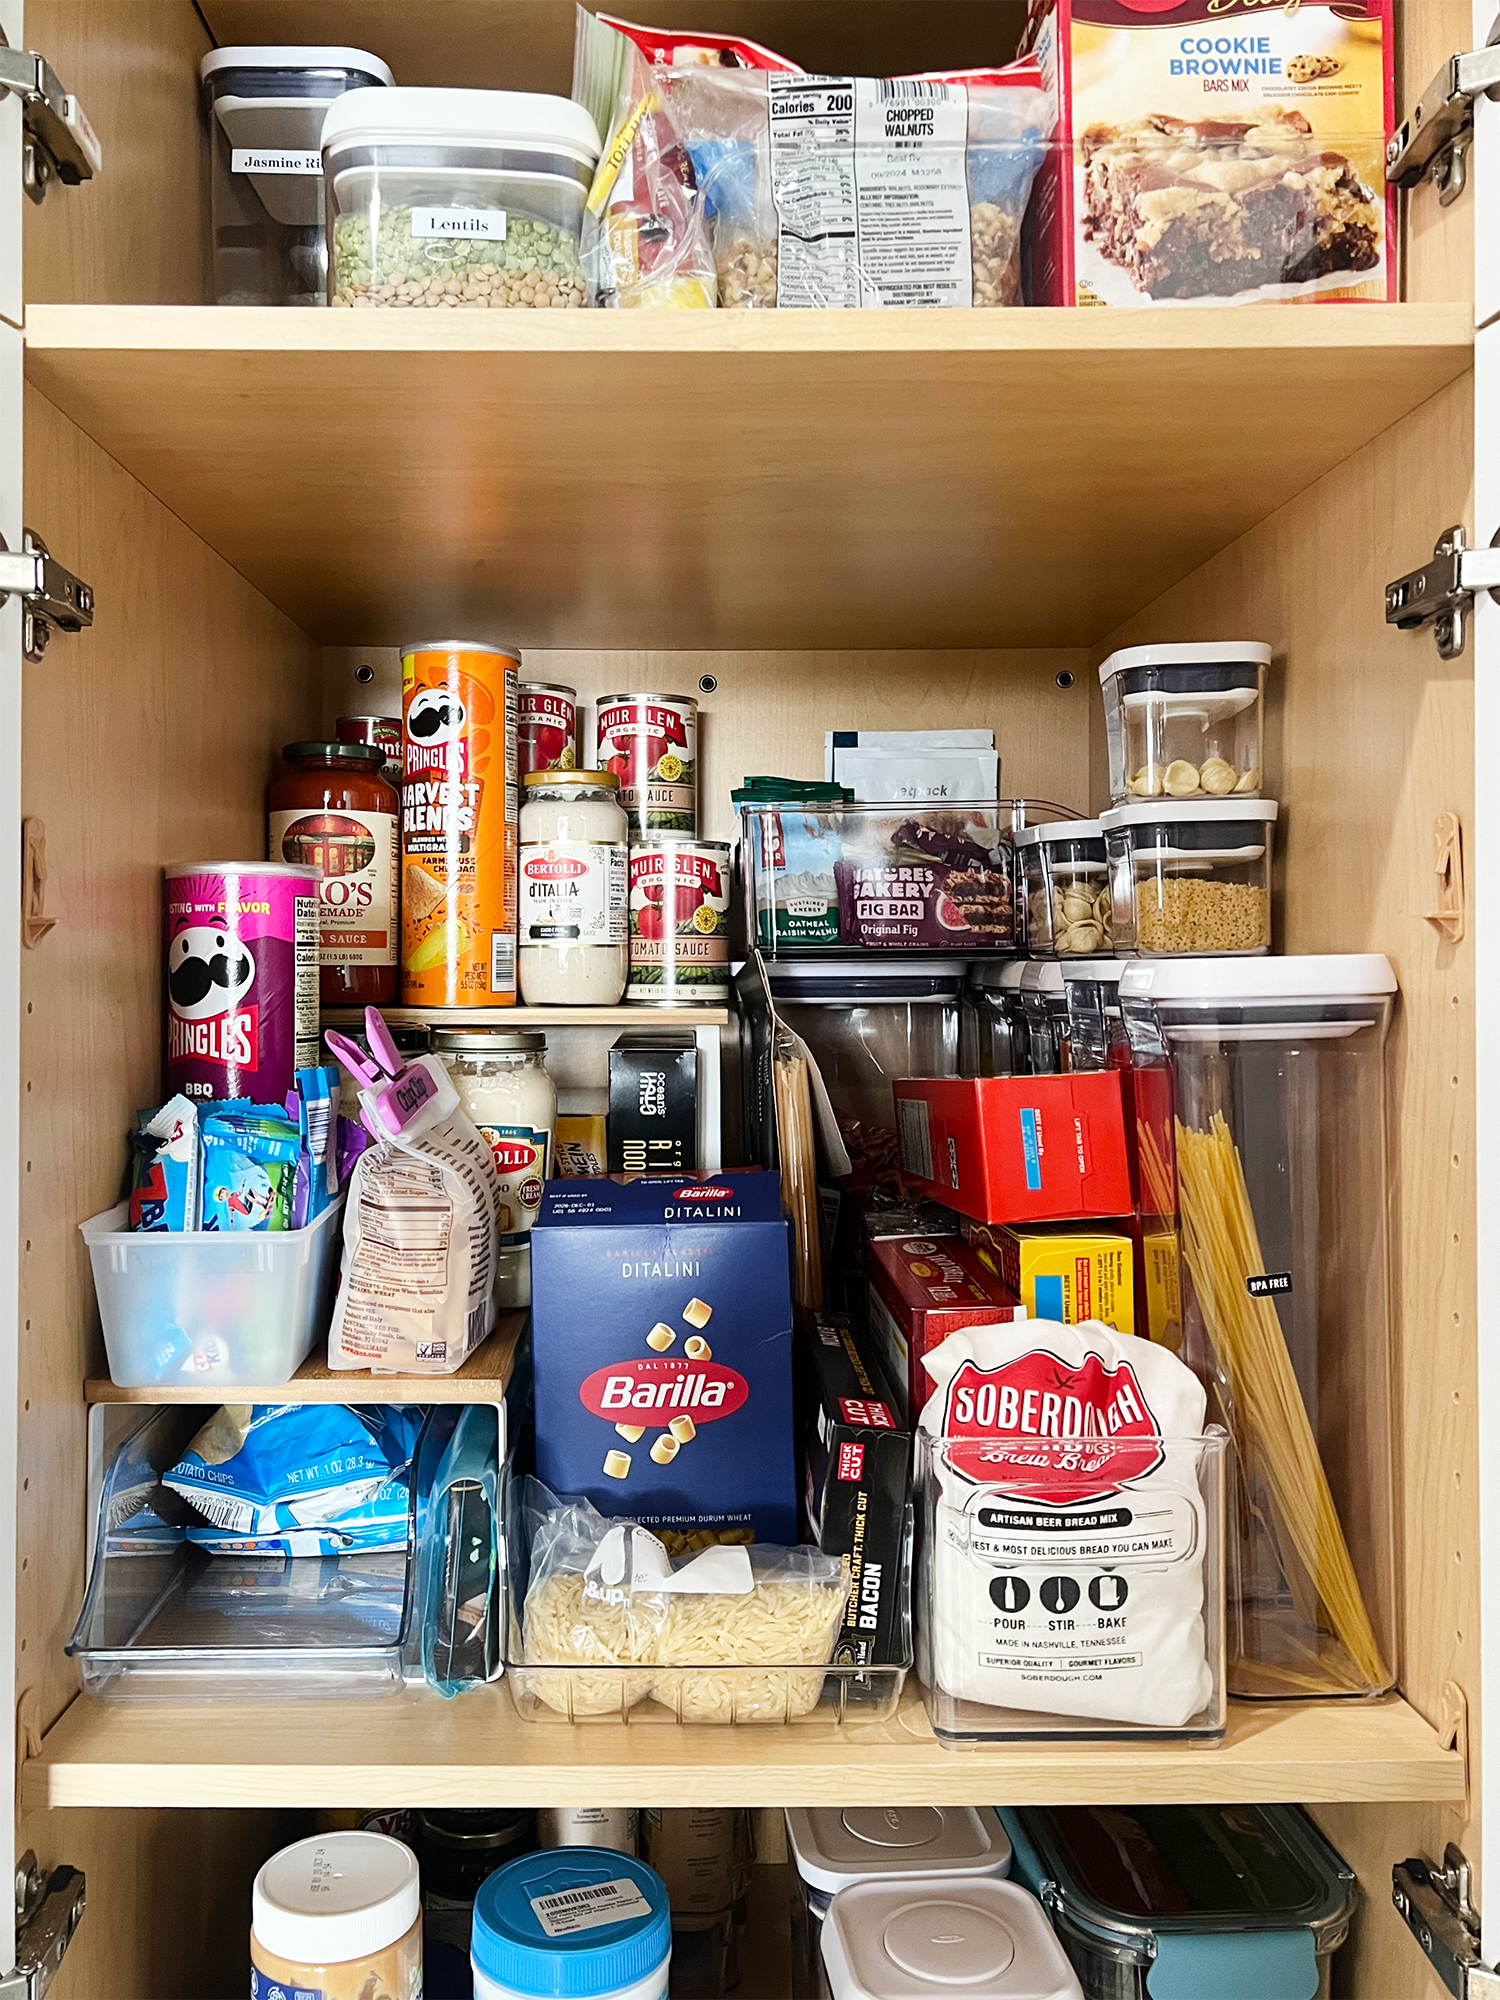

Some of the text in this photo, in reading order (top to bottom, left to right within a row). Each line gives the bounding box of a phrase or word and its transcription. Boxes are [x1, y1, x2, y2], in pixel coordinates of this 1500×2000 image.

[1180, 37, 1270, 54] COOKIE
[1170, 58, 1282, 75] BROWNIE
[1203, 79, 1250, 92] BARS MIX
[772, 95, 852, 114] Calories 200
[886, 108, 934, 122] CHOPPED
[885, 123, 934, 137] WALNUTS
[244, 156, 301, 170] Jasmine
[430, 217, 489, 232] Lentils
[521, 698, 573, 723] IR GLEN
[521, 715, 564, 727] RGANIC
[600, 709, 677, 731] MUIR GLEN
[382, 728, 399, 736] NATURAL
[407, 742, 465, 775] PRINGLES
[403, 781, 480, 806] HARVEST
[616, 789, 674, 802] ATO AUCE
[527, 863, 582, 875] BERTOLLI
[631, 859, 711, 879] MUIR GLEN
[320, 881, 373, 907] O'S
[529, 881, 580, 898] d'ITALIA
[854, 882, 934, 899] BAKERY
[194, 904, 215, 912] WITH
[218, 902, 270, 915] FAVOR
[861, 904, 919, 916] FIG BAR
[788, 920, 830, 928] OATMEAL
[861, 924, 918, 937] Original Fig
[776, 927, 839, 937] RAISIN WALNU
[329, 935, 368, 944] SAUCE
[630, 943, 710, 956] TOMATO SAUCE
[472, 962, 480, 970] NET
[465, 971, 487, 980] PESO NETO
[169, 1014, 252, 1063] PRINGLES
[185, 1083, 213, 1096] BBQ
[640, 1072, 657, 1115] HALO
[657, 1072, 667, 1116] ocean's
[623, 1140, 646, 1170] NOO
[1077, 1145, 1083, 1154] TO
[493, 1149, 529, 1165] OLLI
[522, 1185, 541, 1193] FRESH
[522, 1192, 541, 1200] CREAM
[679, 1188, 727, 1198] Barilla
[664, 1206, 741, 1219] DITALINI
[622, 1261, 700, 1278] DITALINI
[383, 1285, 400, 1293] Durum
[1251, 1277, 1289, 1291] BPA FREE
[373, 1289, 396, 1297] WHEAT
[385, 1304, 411, 1312] equipment
[369, 1315, 383, 1323] Italy
[638, 1362, 689, 1371] DAL 1877
[600, 1373, 727, 1408] Barilla
[844, 1400, 872, 1426] CUT
[867, 1402, 890, 1428] THICK
[955, 1384, 1143, 1438] SOBERDOUGH
[841, 1444, 852, 1479] THICK
[850, 1445, 863, 1480] CUT
[979, 1450, 1049, 1467] Brew
[287, 1455, 364, 1484] NET WT. 1 OZ (28.3
[207, 1470, 235, 1485] CHIPS
[380, 1487, 393, 1500] OZ.
[662, 1515, 696, 1523] PREMIUM
[727, 1514, 752, 1522] WHEAT
[990, 1513, 1118, 1527] ARTISAN BEER BREAD MIX
[993, 1538, 1173, 1556] & MOST DELICIOUS BREAD YOU CAN MAKE
[847, 1491, 868, 1627] BUTCHER THICK CUT
[859, 1563, 882, 1630] BACON
[994, 1618, 1026, 1630] POUR
[1048, 1619, 1075, 1631] STIR
[1097, 1617, 1127, 1629] BAKE
[996, 1638, 1019, 1648] MADE
[1021, 1640, 1030, 1648] IN
[1081, 1637, 1127, 1648] TENNESSEE
[986, 1657, 1053, 1667] SUPERIOR QUALITY
[1104, 1656, 1136, 1666] FLAVORS
[1021, 1674, 1102, 1682] SOBERDOUGH.COM
